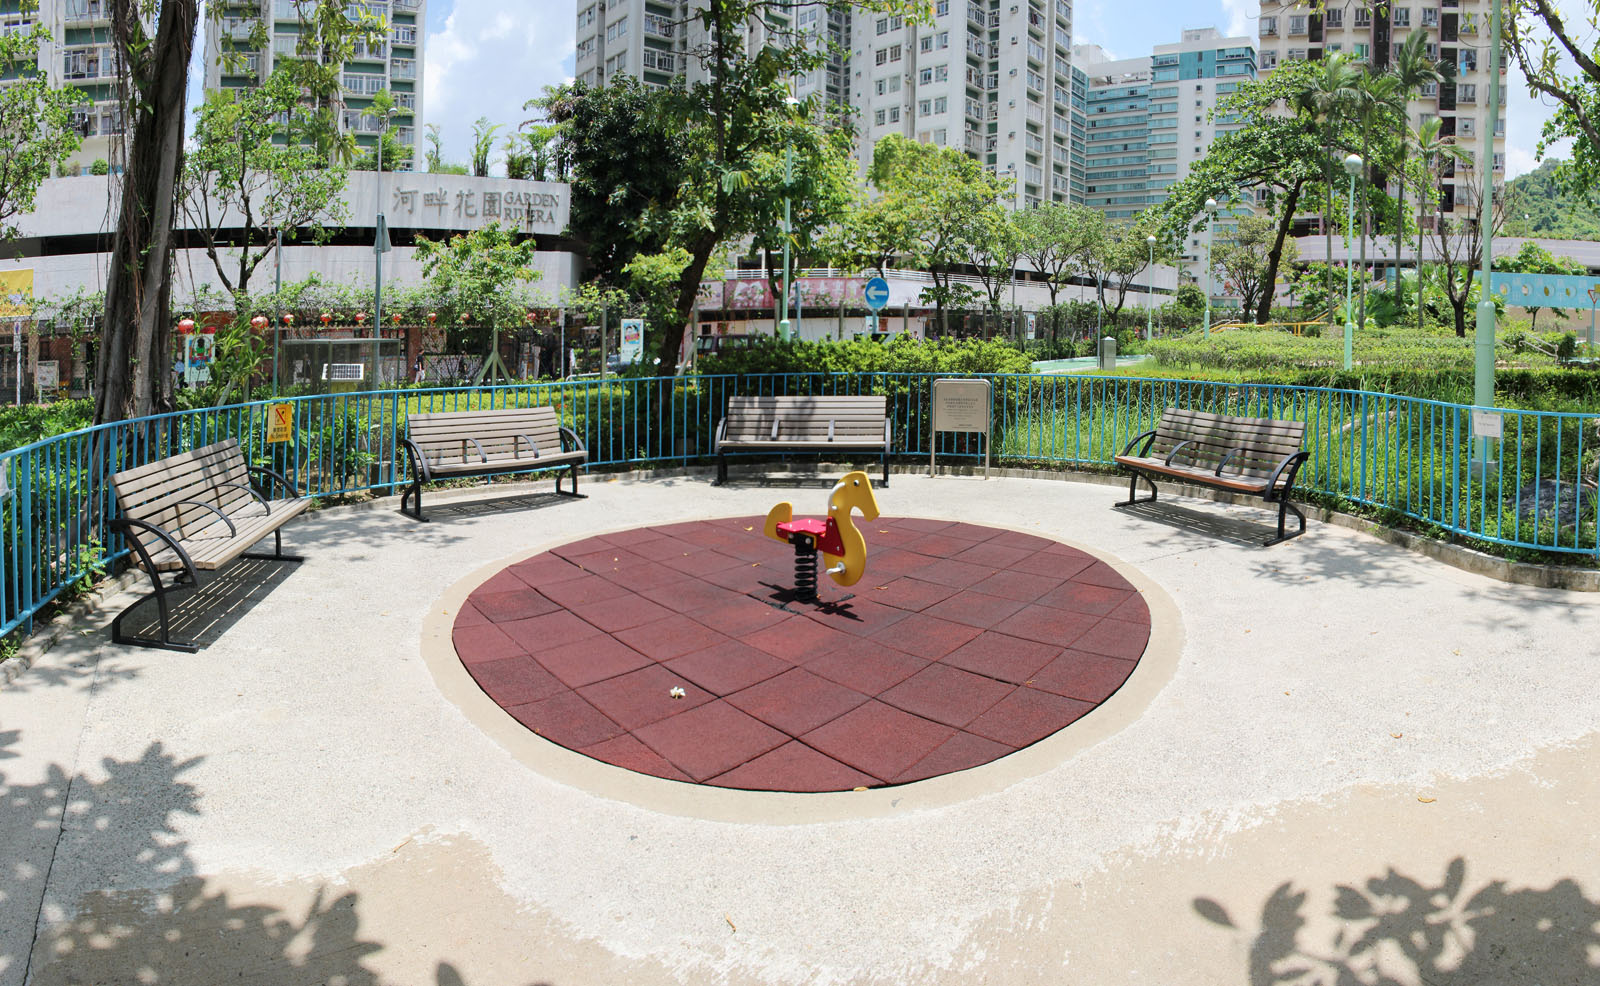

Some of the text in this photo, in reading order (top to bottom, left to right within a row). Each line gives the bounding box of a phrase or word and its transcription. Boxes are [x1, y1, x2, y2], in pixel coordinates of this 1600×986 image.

[393, 186, 502, 218] 河畔花園
[504, 191, 559, 207] GARDEN
[503, 208, 555, 224] RIVERA
